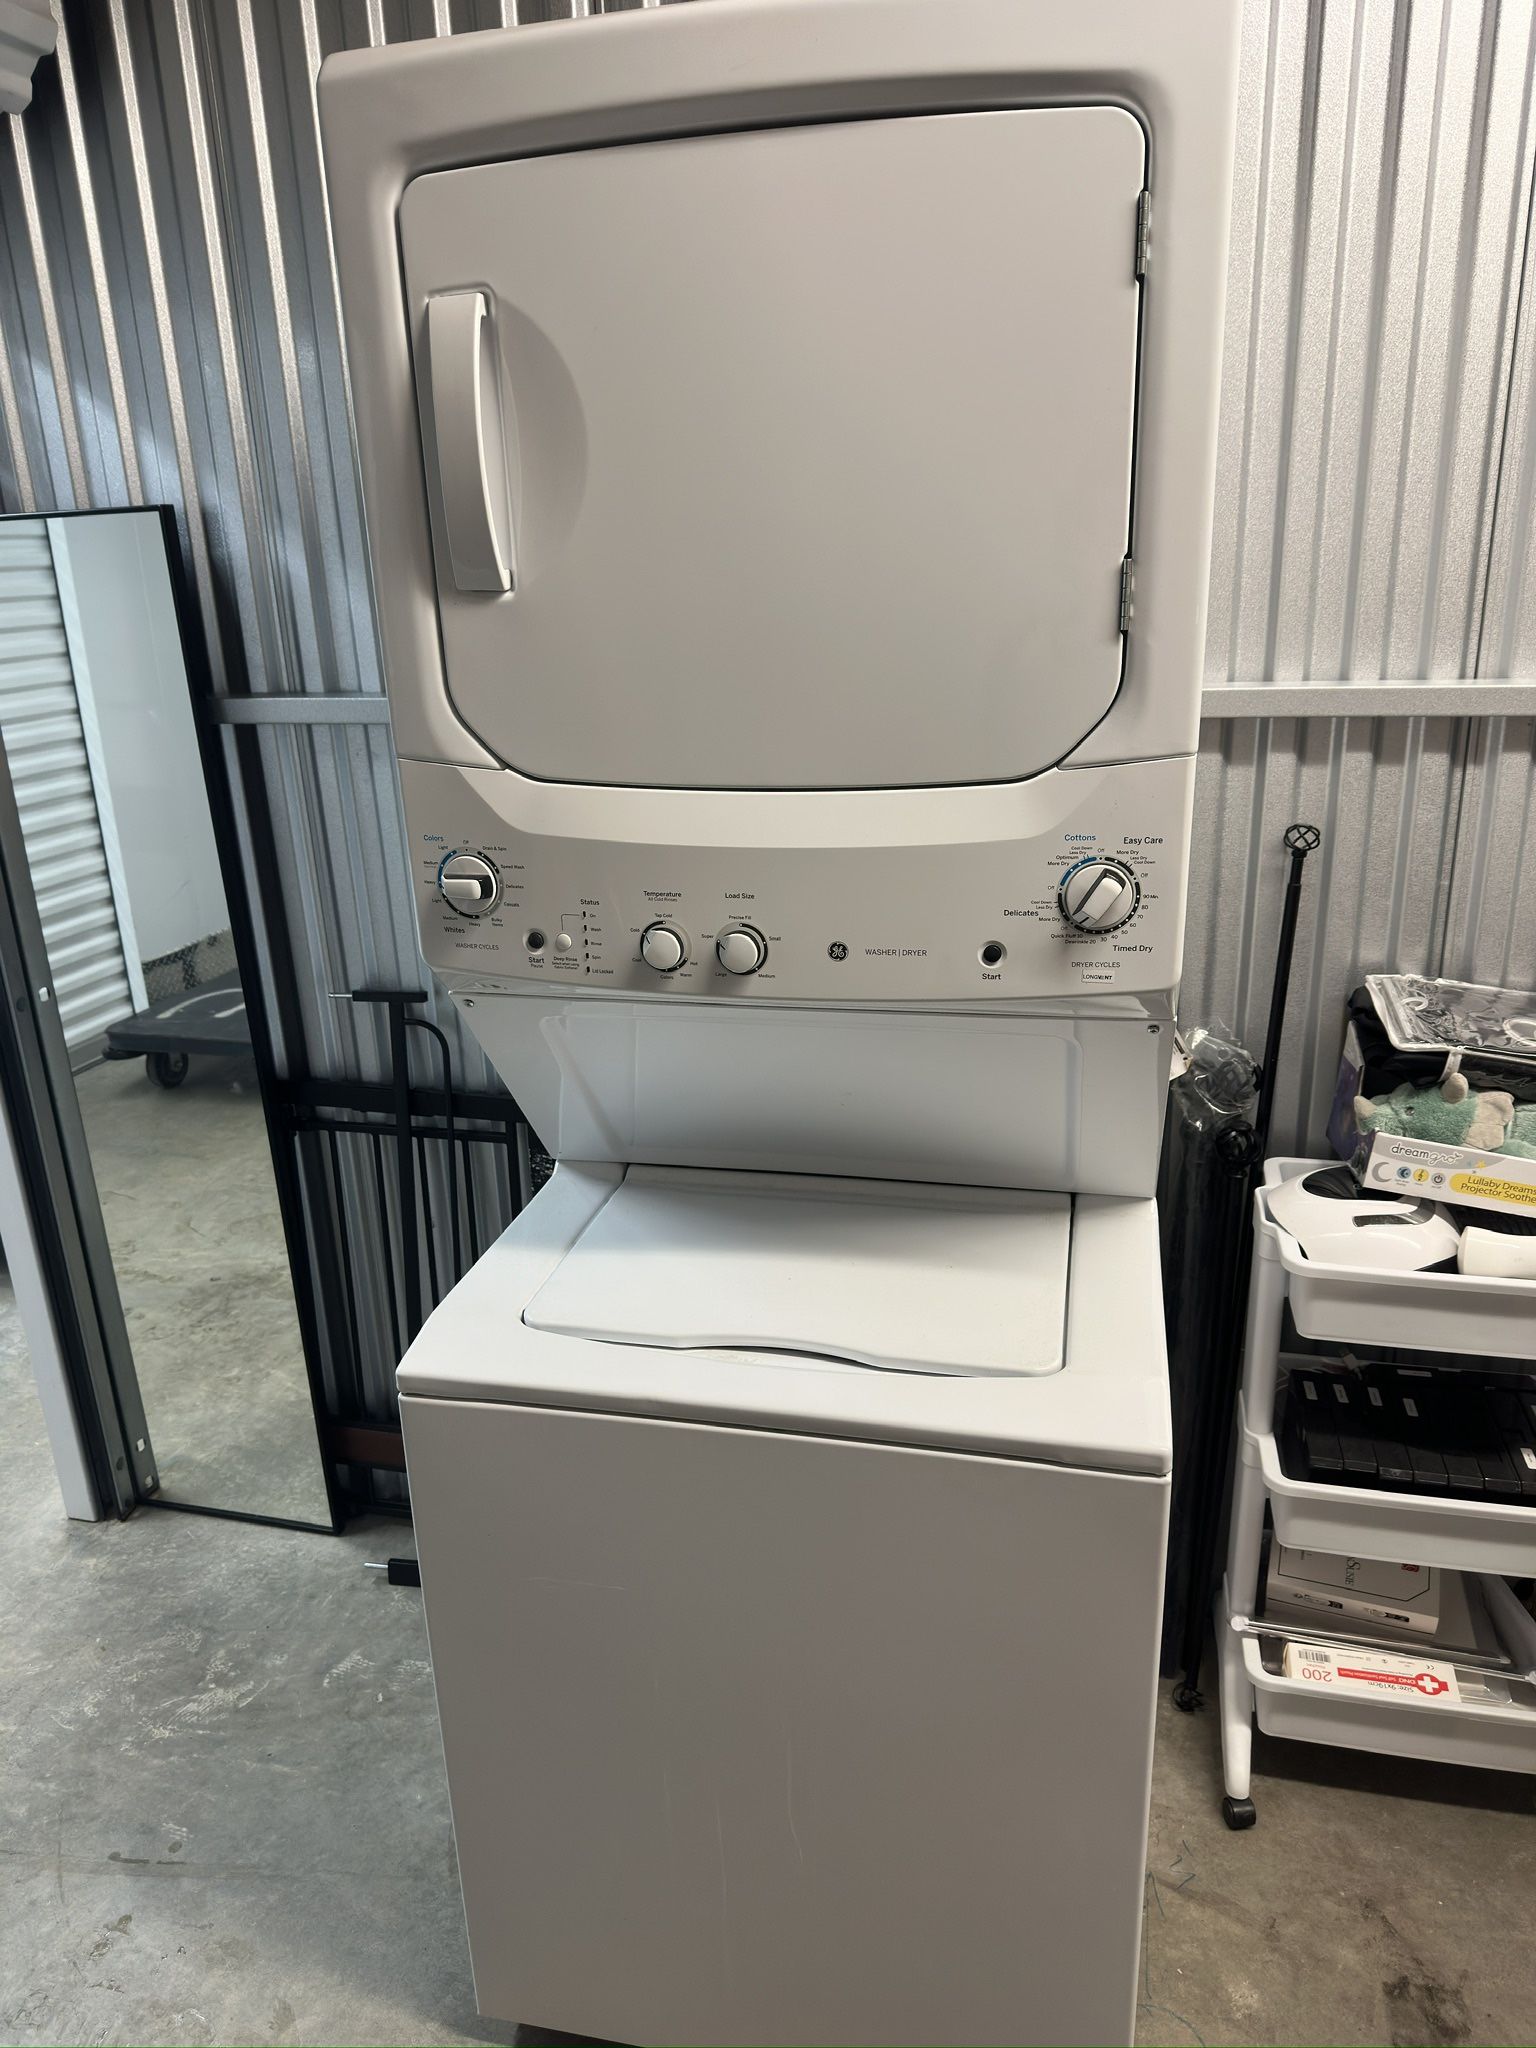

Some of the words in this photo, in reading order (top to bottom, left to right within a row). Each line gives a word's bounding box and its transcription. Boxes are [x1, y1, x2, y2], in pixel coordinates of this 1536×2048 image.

[423, 834, 444, 842] Colors
[1064, 834, 1097, 842] Cottons
[1123, 837, 1143, 846] Easy
[1144, 837, 1164, 845] Care
[643, 890, 682, 898] Temperature
[580, 898, 600, 906] Status
[1003, 909, 1039, 917] Delicates
[444, 926, 466, 934] Whites
[455, 942, 478, 950] WASHER
[479, 943, 500, 951] CYCLES
[1139, 945, 1154, 953] Dry
[864, 948, 898, 957] WASHER
[902, 948, 928, 957] DRYER
[528, 956, 545, 964] Start
[1094, 961, 1121, 969] CYCLES
[981, 972, 1002, 981] Start
[1467, 1175, 1501, 1189] Lullaby
[1460, 1182, 1502, 1197] Projector
[1302, 1667, 1332, 1683] 200
[1398, 1685, 1414, 1693] Size:
